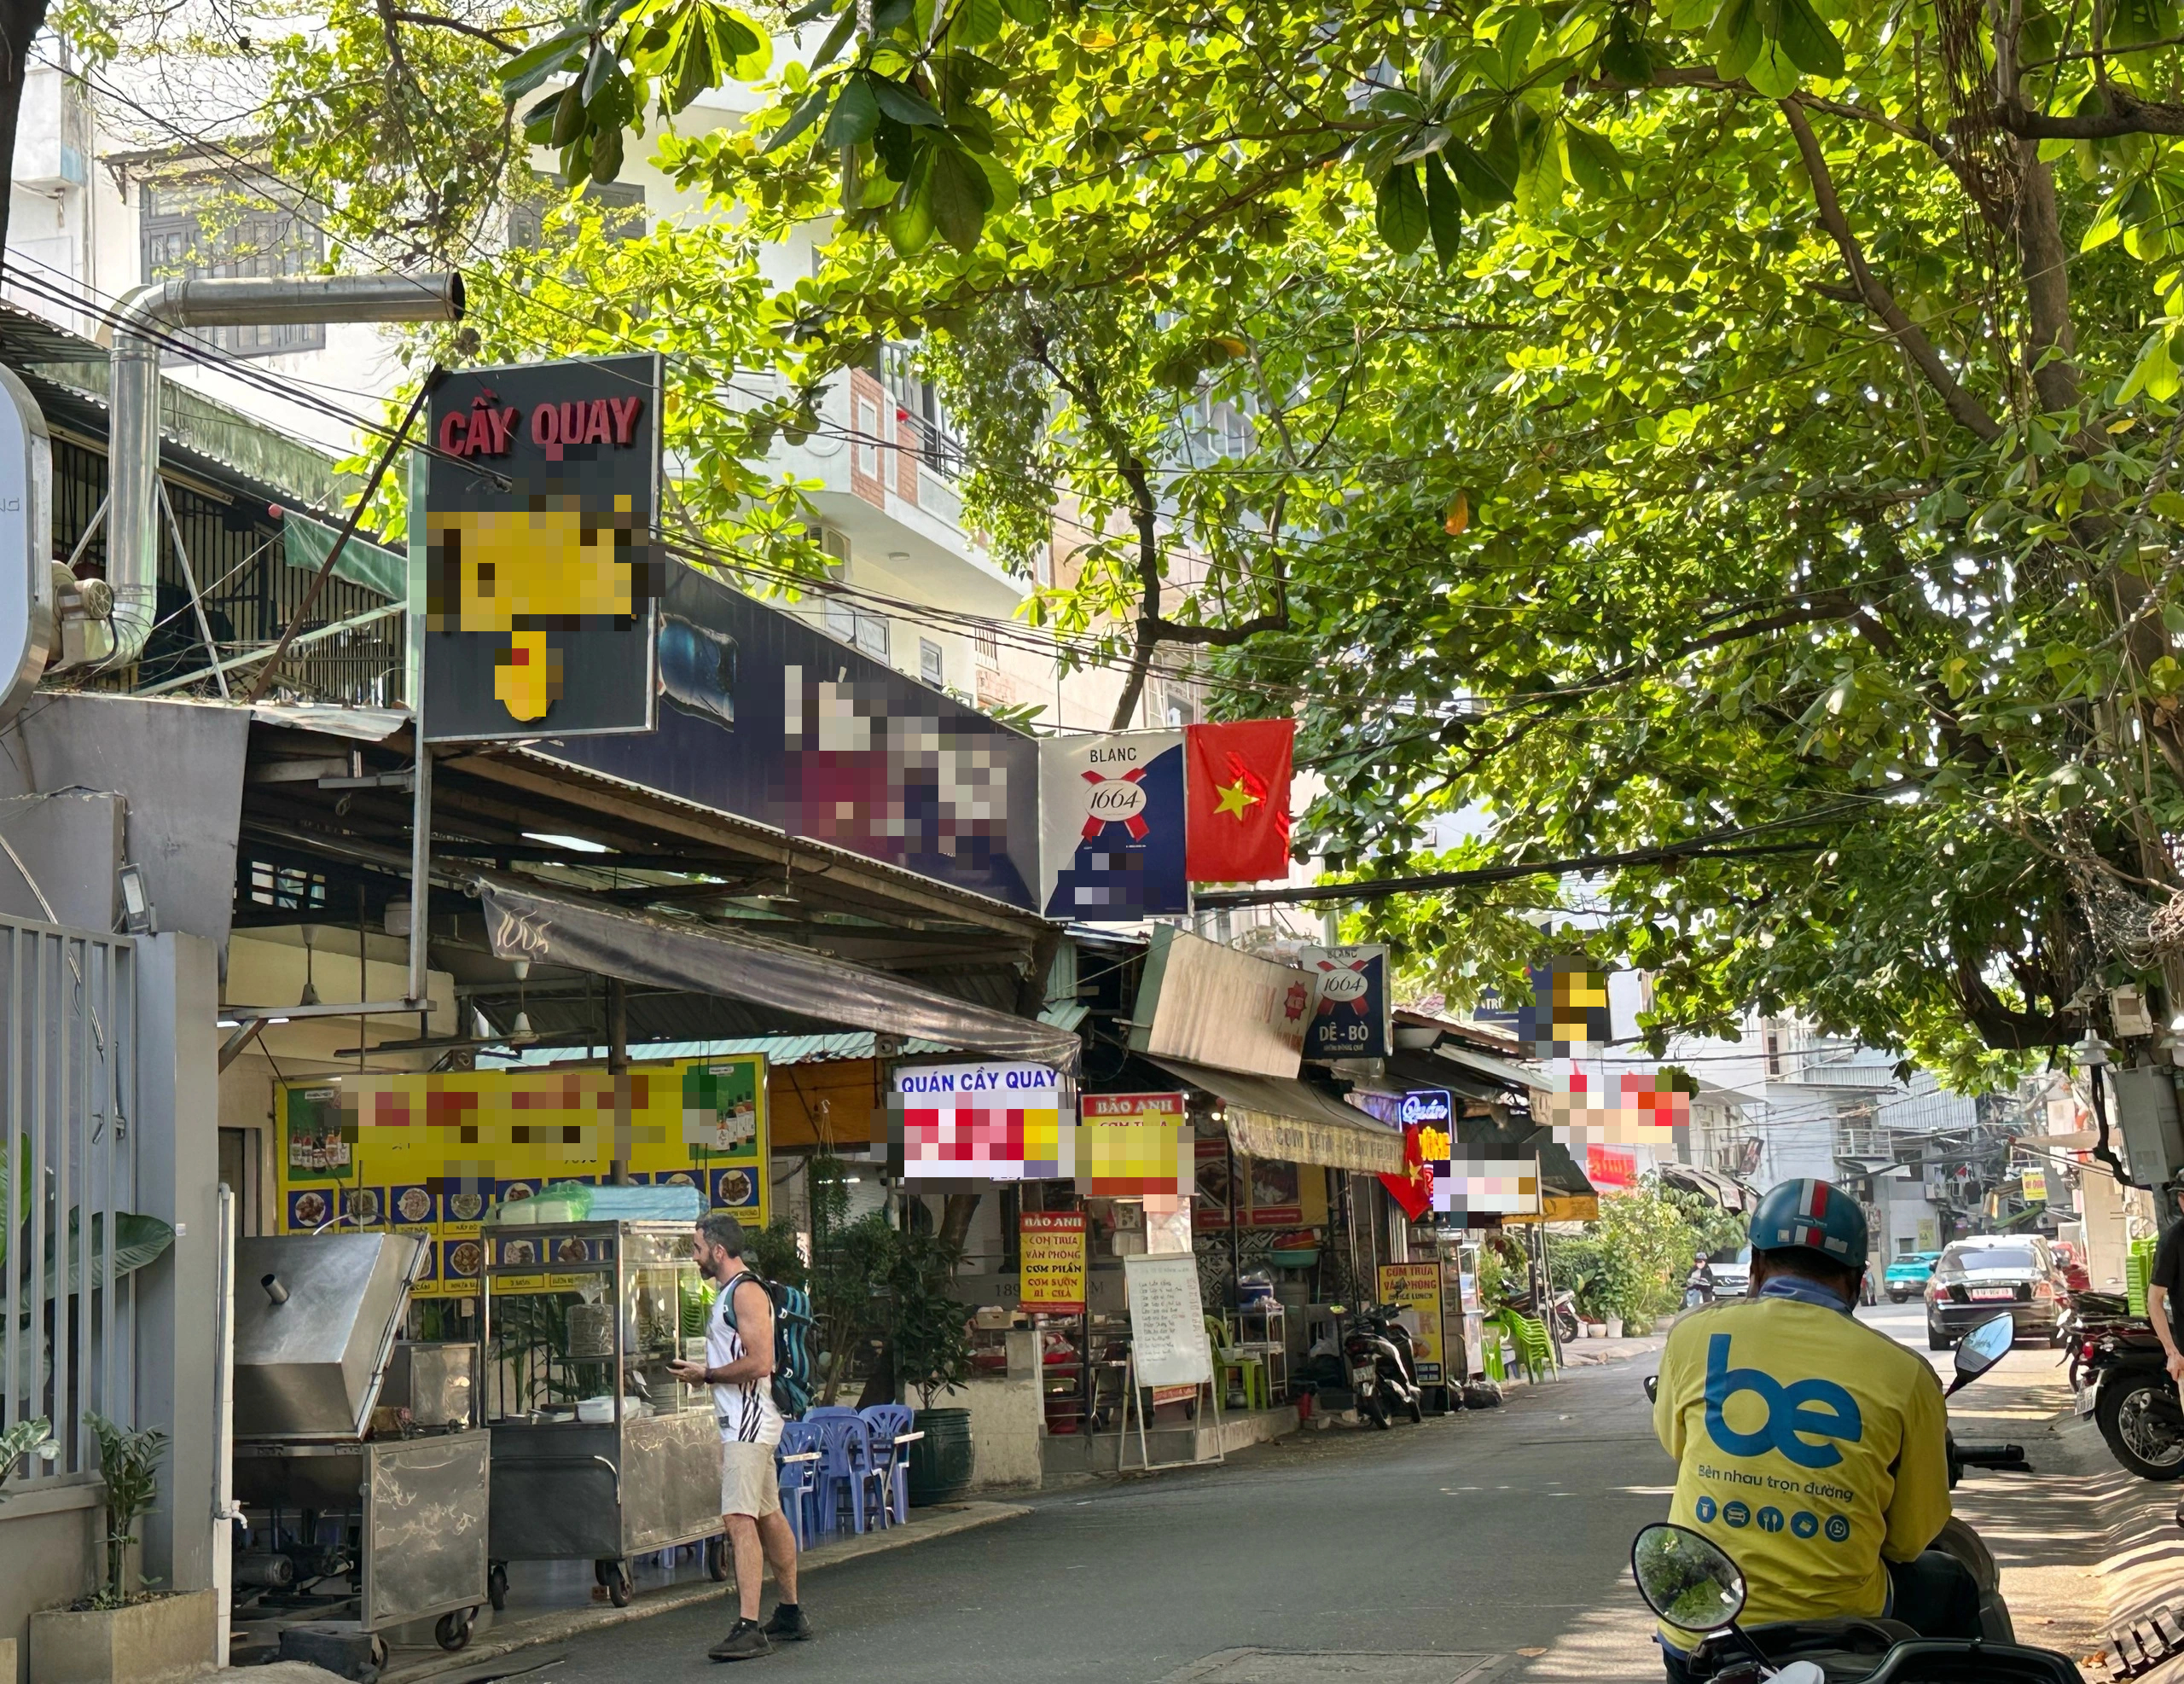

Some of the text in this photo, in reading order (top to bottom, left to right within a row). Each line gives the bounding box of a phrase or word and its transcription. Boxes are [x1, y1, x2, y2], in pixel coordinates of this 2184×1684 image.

[531, 397, 642, 449] QUAY
[1089, 747, 1137, 763] BLANC
[1090, 788, 1141, 810] 1664
[1323, 976, 1363, 992] 1664
[1348, 1020, 1369, 1041] BÒ
[902, 1071, 955, 1092] QUÁN
[1006, 1070, 1059, 1090] QUAY
[1135, 1100, 1173, 1113] ANH
[1054, 1217, 1082, 1227] ANH
[1704, 1333, 1862, 1469] be
[1723, 1470, 1763, 1486] nhau
[1767, 1475, 1799, 1494] trọn
[1804, 1482, 1854, 1503] đường
